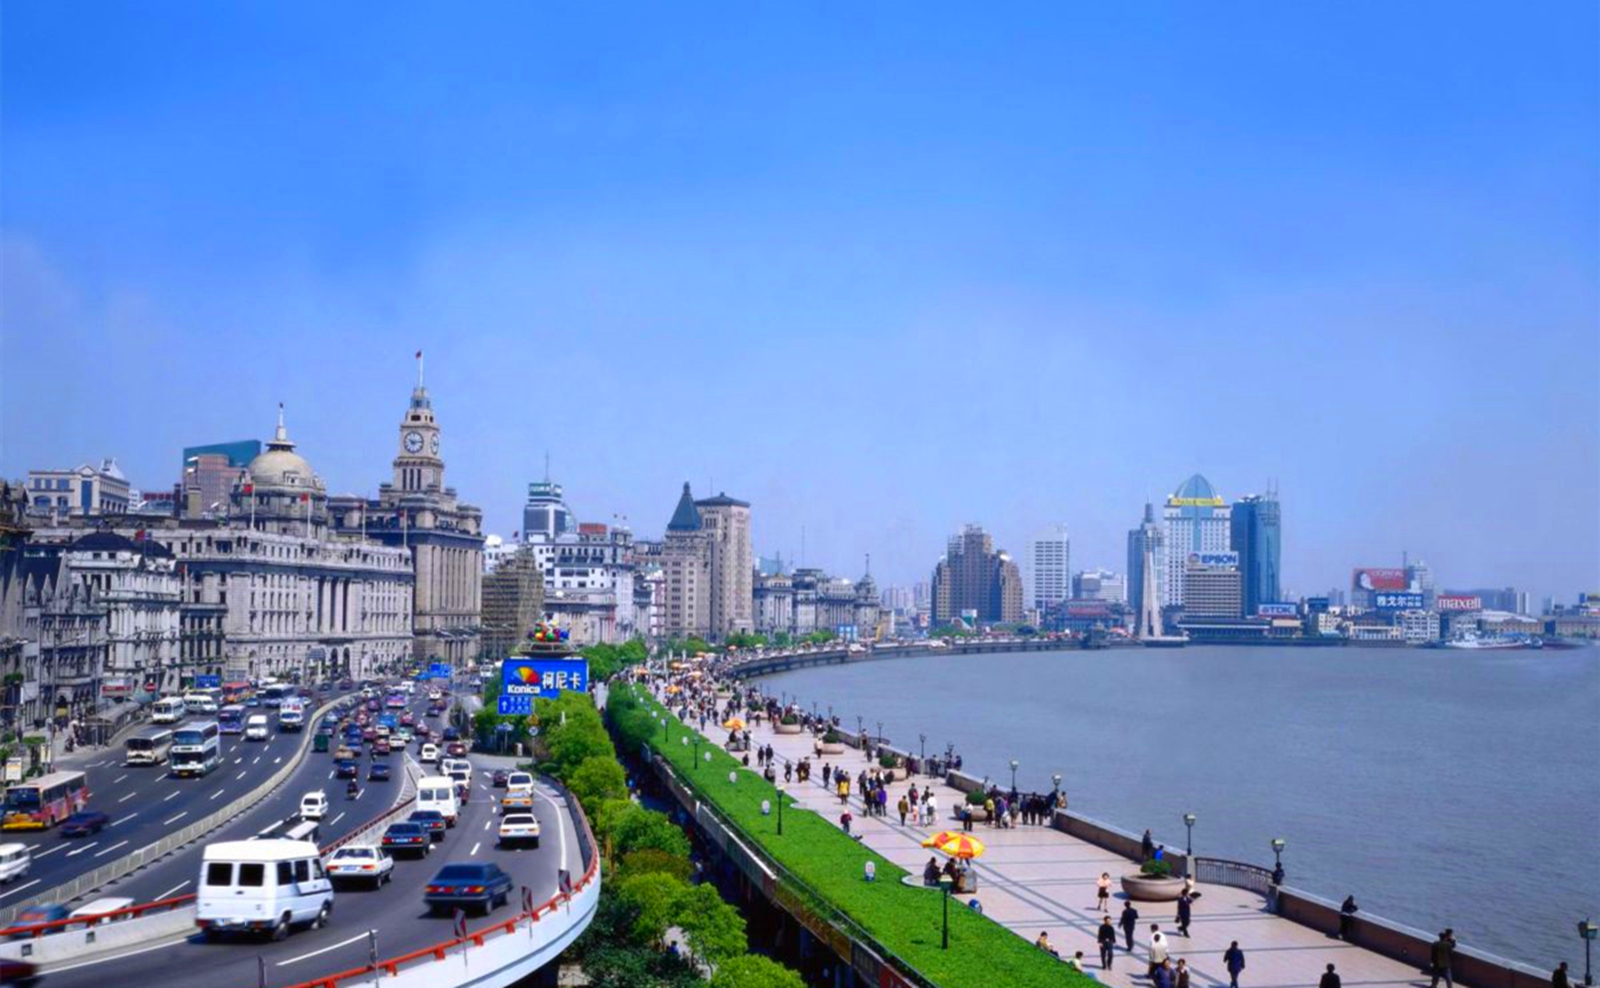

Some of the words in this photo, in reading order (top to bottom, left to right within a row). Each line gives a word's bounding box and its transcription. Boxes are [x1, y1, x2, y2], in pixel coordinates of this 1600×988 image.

[1201, 554, 1237, 565] EPSON
[1438, 597, 1482, 609] maxell
[1270, 606, 1292, 614] TDK
[542, 671, 582, 690] 柯尼卡
[507, 683, 541, 694] Konica
